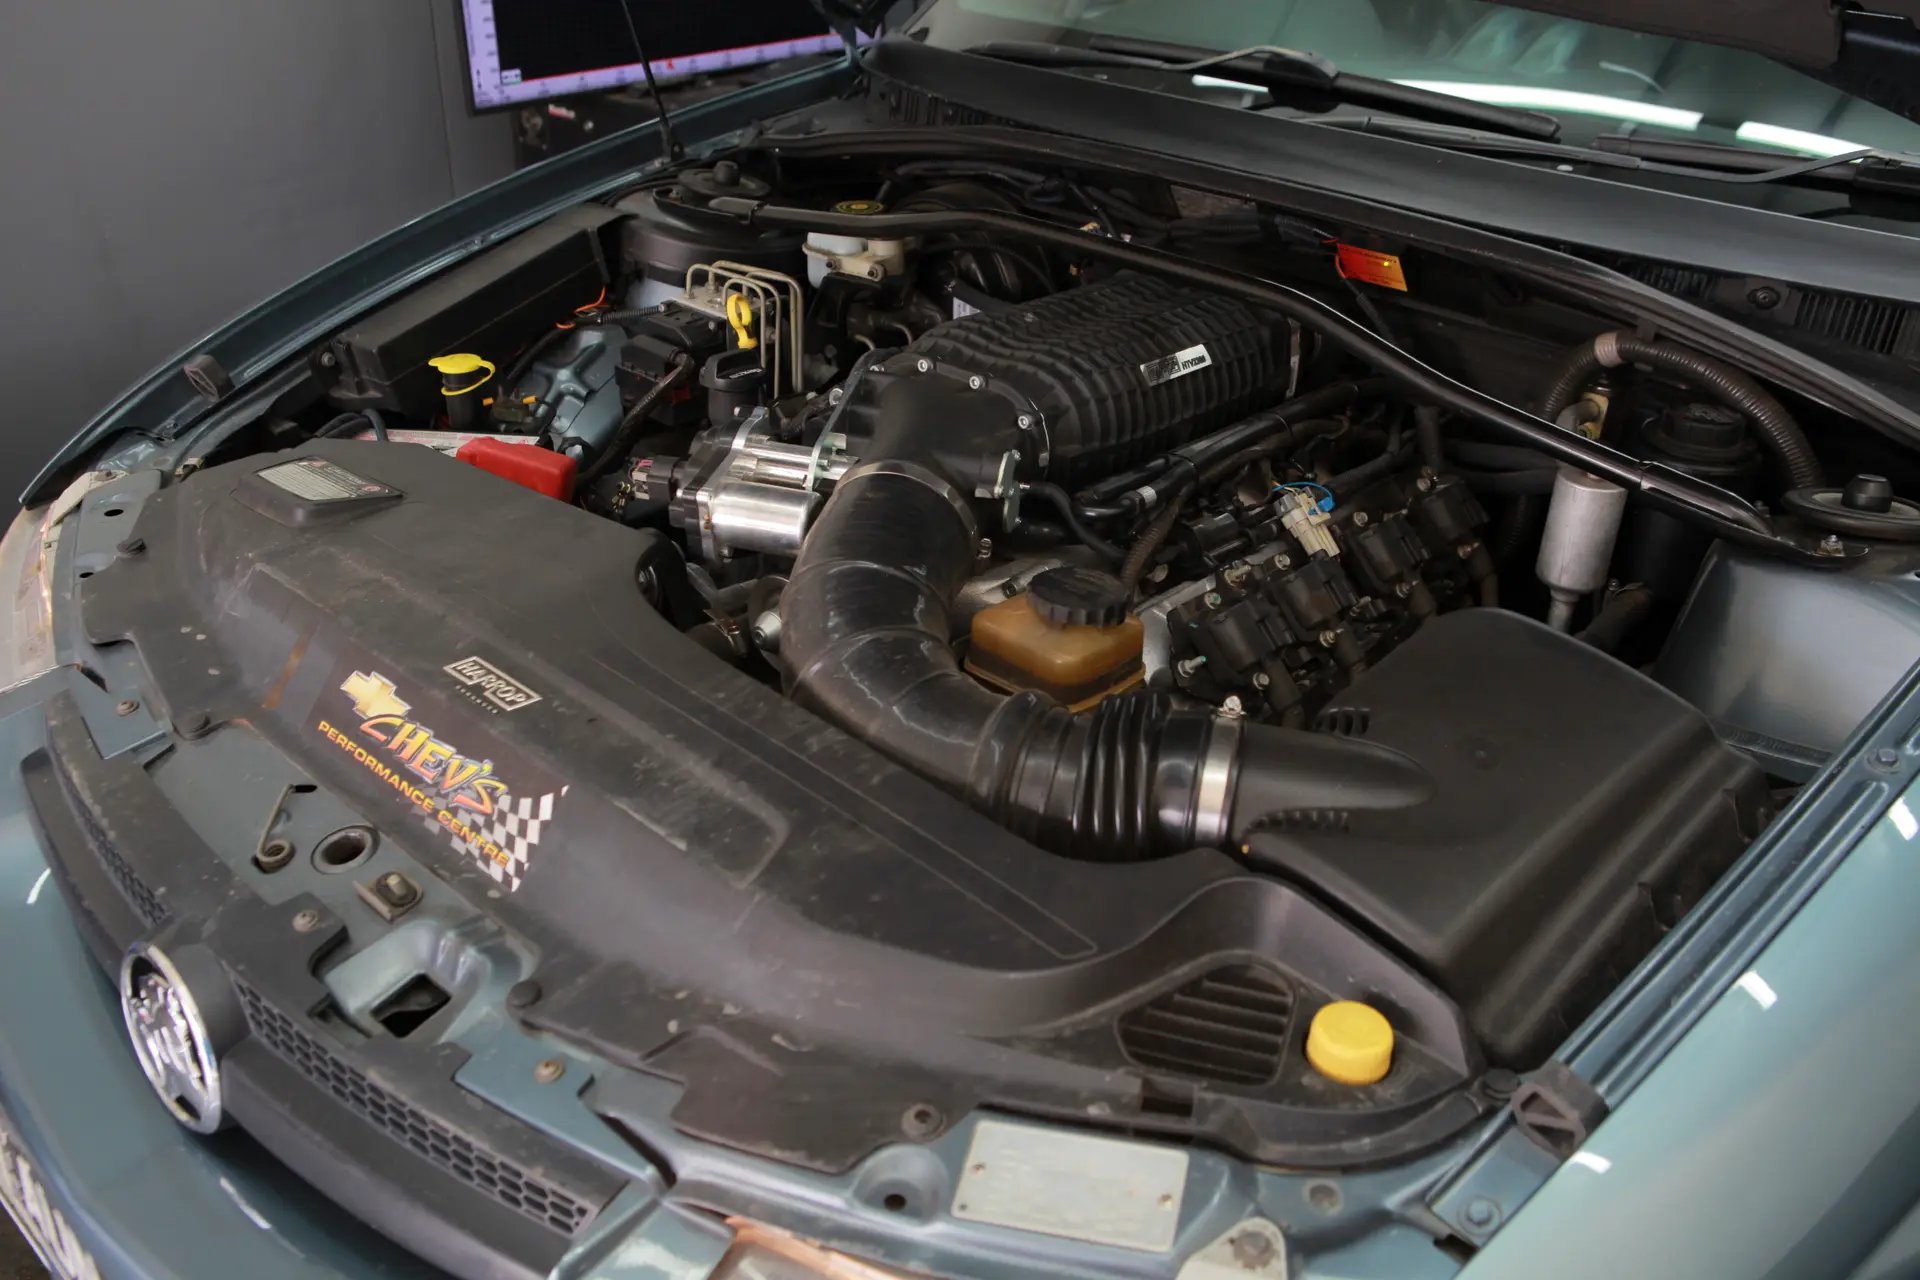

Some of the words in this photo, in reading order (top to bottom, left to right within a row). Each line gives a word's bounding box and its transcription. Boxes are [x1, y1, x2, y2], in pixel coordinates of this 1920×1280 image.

[456, 661, 527, 702] HARROP
[318, 720, 435, 813] PERFORMANCE
[438, 809, 511, 869] CENTRE
[359, 713, 508, 815] CHEV'S
